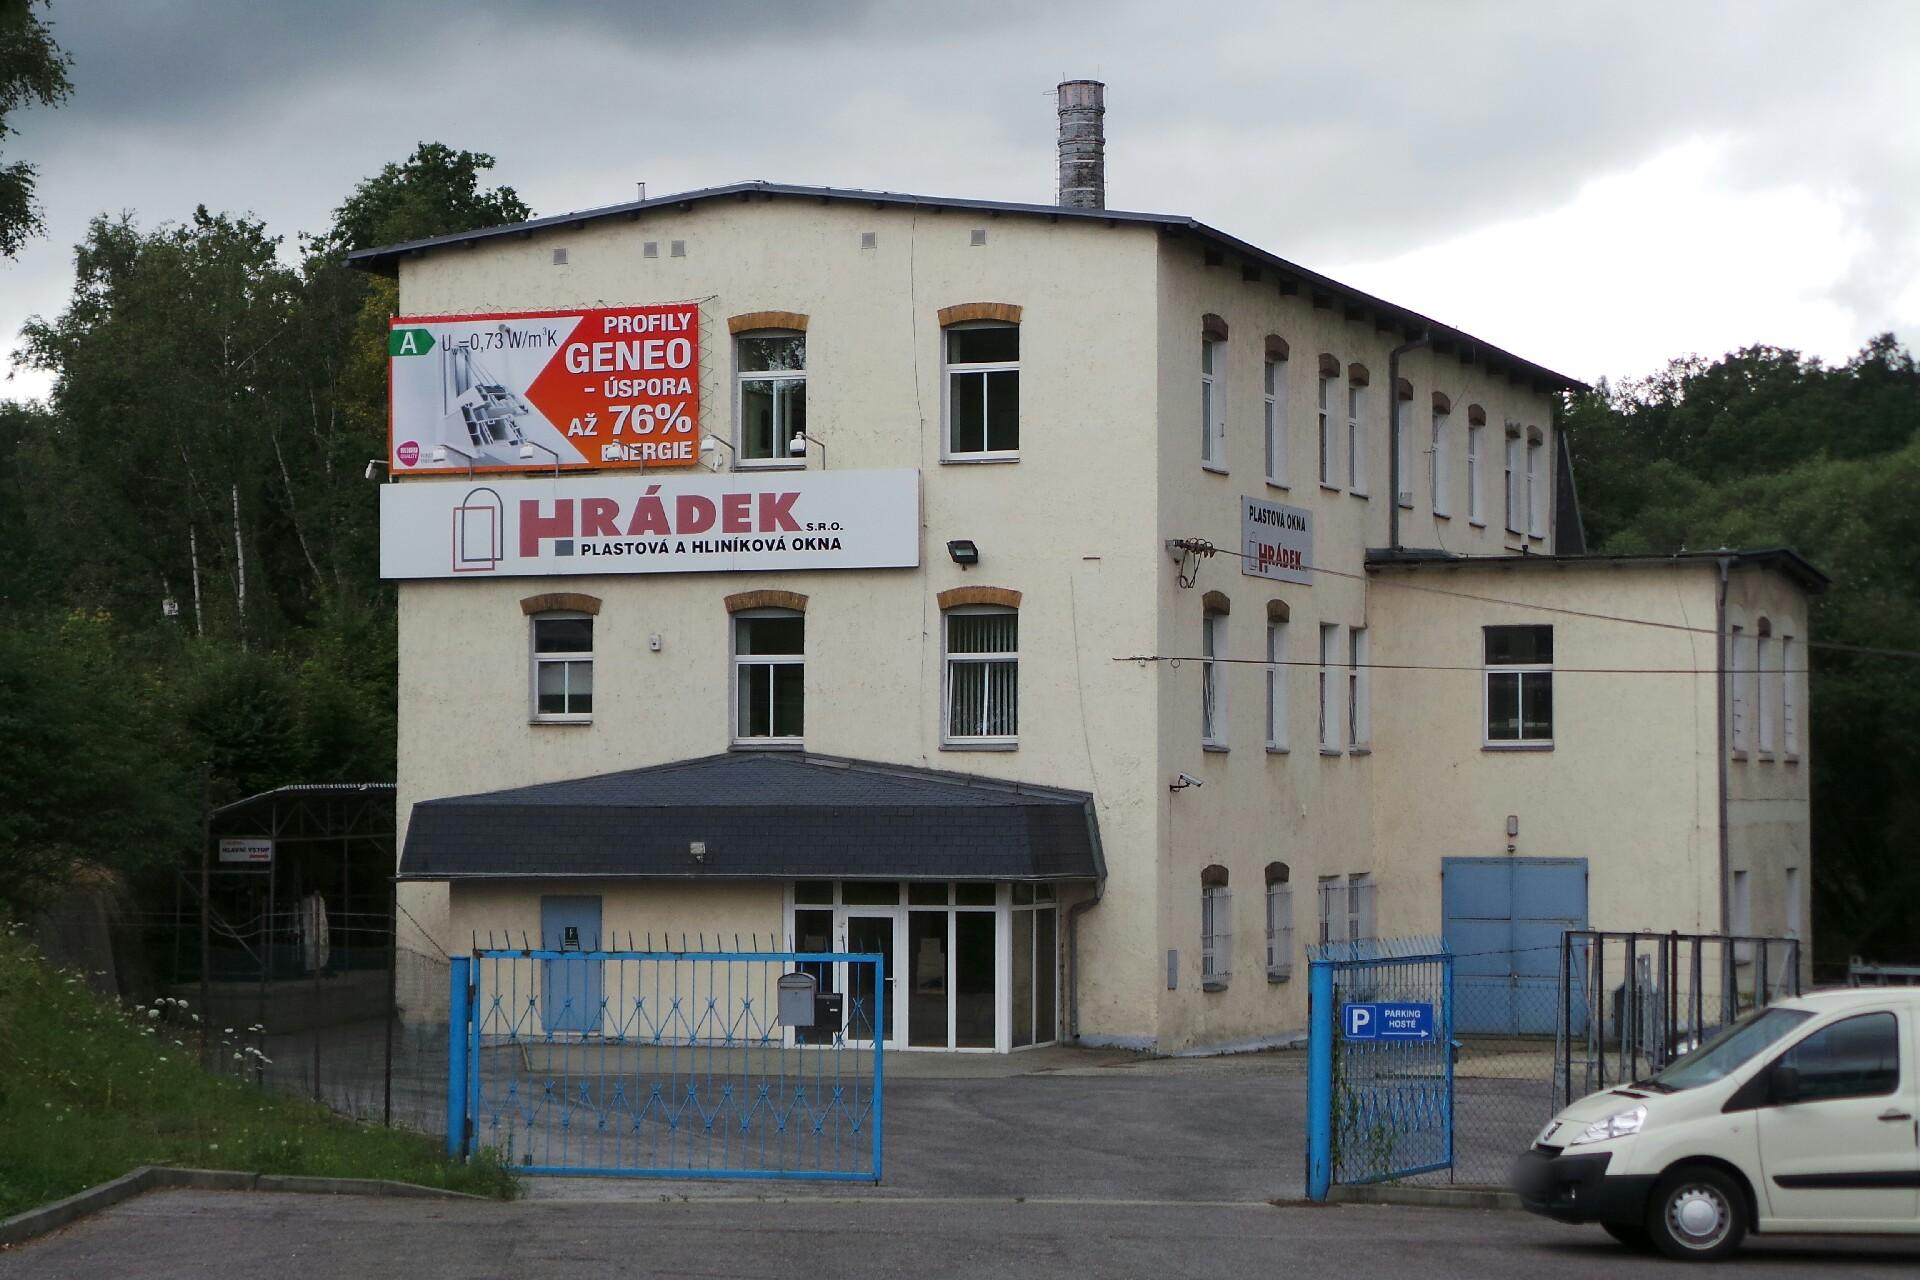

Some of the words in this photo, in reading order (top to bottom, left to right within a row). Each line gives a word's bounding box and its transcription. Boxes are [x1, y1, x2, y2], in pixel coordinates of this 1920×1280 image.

[604, 312, 691, 334] PROFILY
[399, 331, 418, 354] A
[565, 337, 692, 374] GENEO
[604, 376, 692, 398] ÚSPORA
[567, 412, 598, 437] AŽ
[608, 401, 692, 435] 76%
[519, 484, 803, 558] HRÁDEK
[806, 521, 844, 532] S.R.O.
[1249, 505, 1285, 529] PLASTOVÁ
[1287, 513, 1306, 532] OKNA
[581, 539, 669, 556] PLASTOVÁ
[675, 541, 686, 554] A
[692, 536, 787, 553] HLINÍKOVÁ
[791, 537, 842, 551] OKNA
[1258, 542, 1302, 573] HRÁDEK
[1352, 1008, 1370, 1034] P
[1384, 1009, 1421, 1018] PARKING
